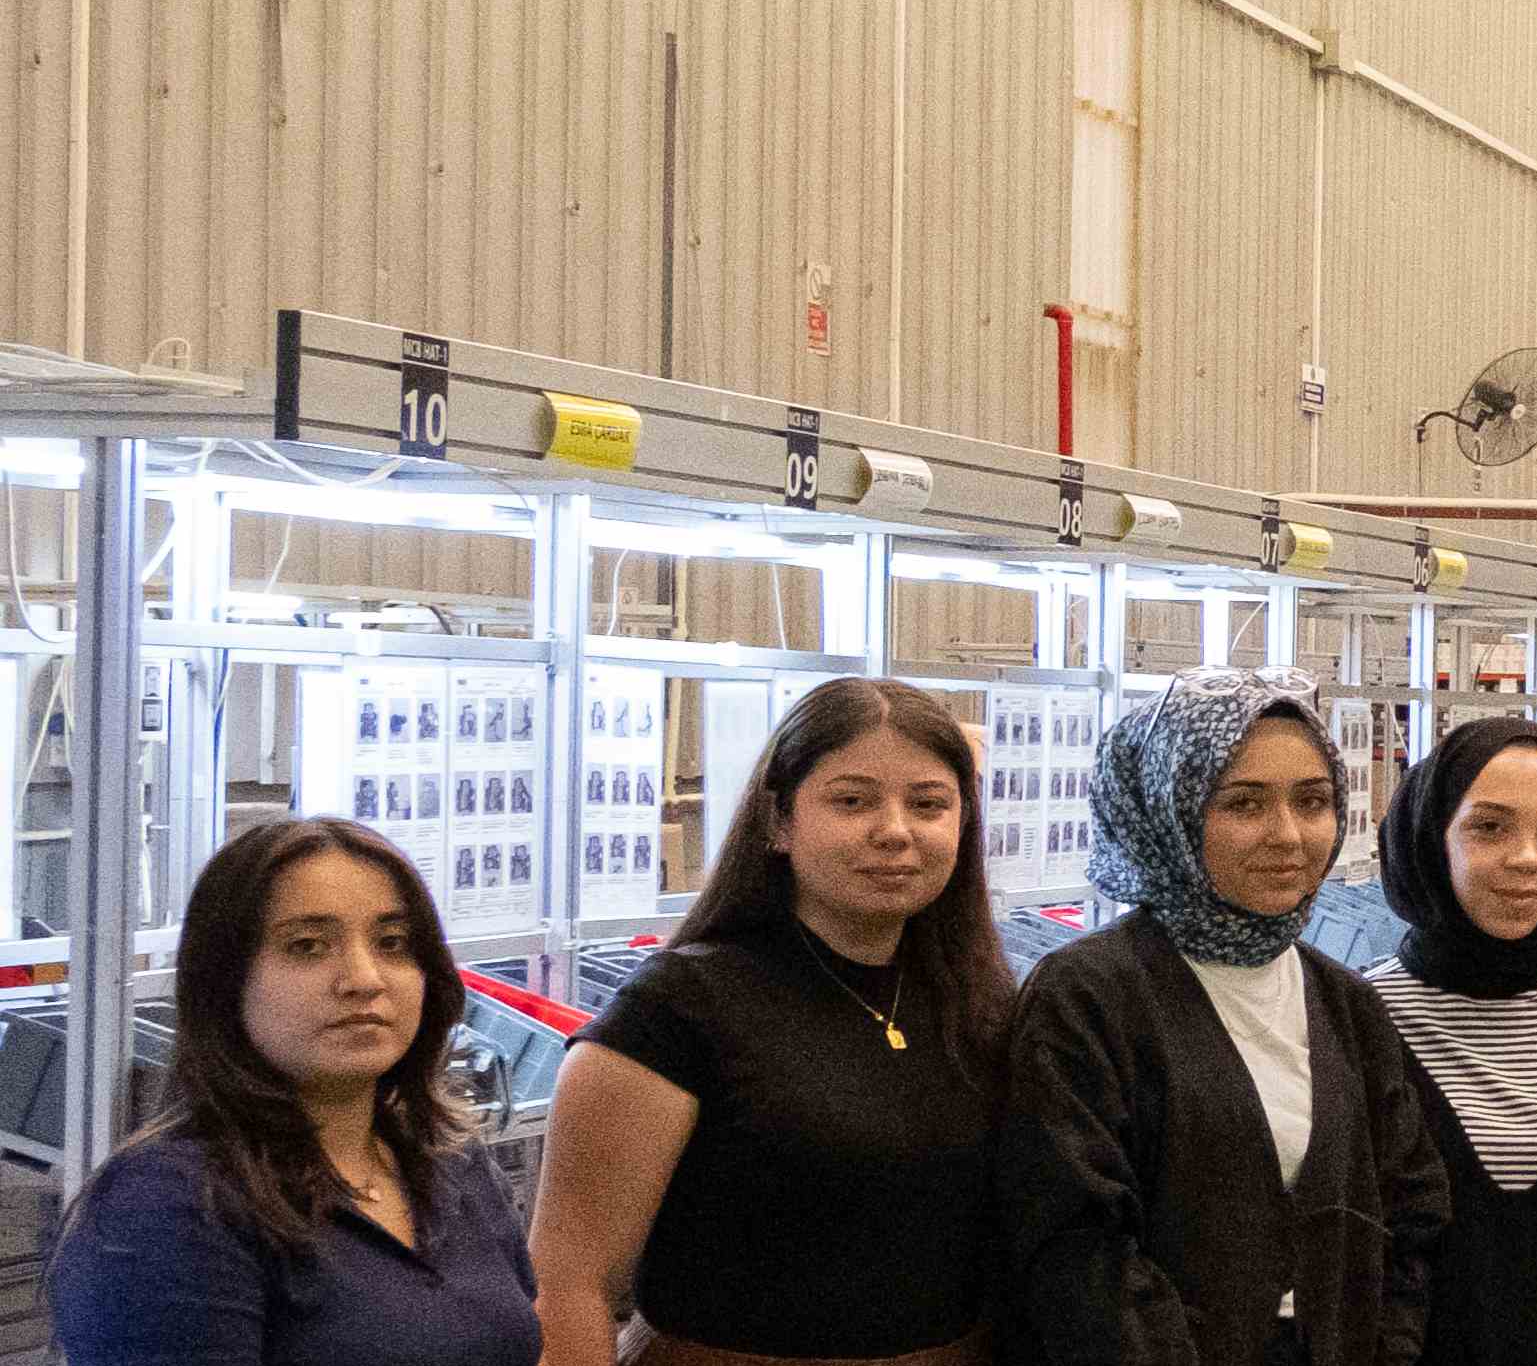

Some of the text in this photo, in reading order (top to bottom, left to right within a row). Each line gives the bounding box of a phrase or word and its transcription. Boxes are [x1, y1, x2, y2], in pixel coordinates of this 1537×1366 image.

[403, 389, 447, 447] 10
[787, 452, 817, 499] 09
[1060, 498, 1081, 538] 08
[1261, 531, 1279, 565] 07
[1414, 555, 1429, 585] 06
